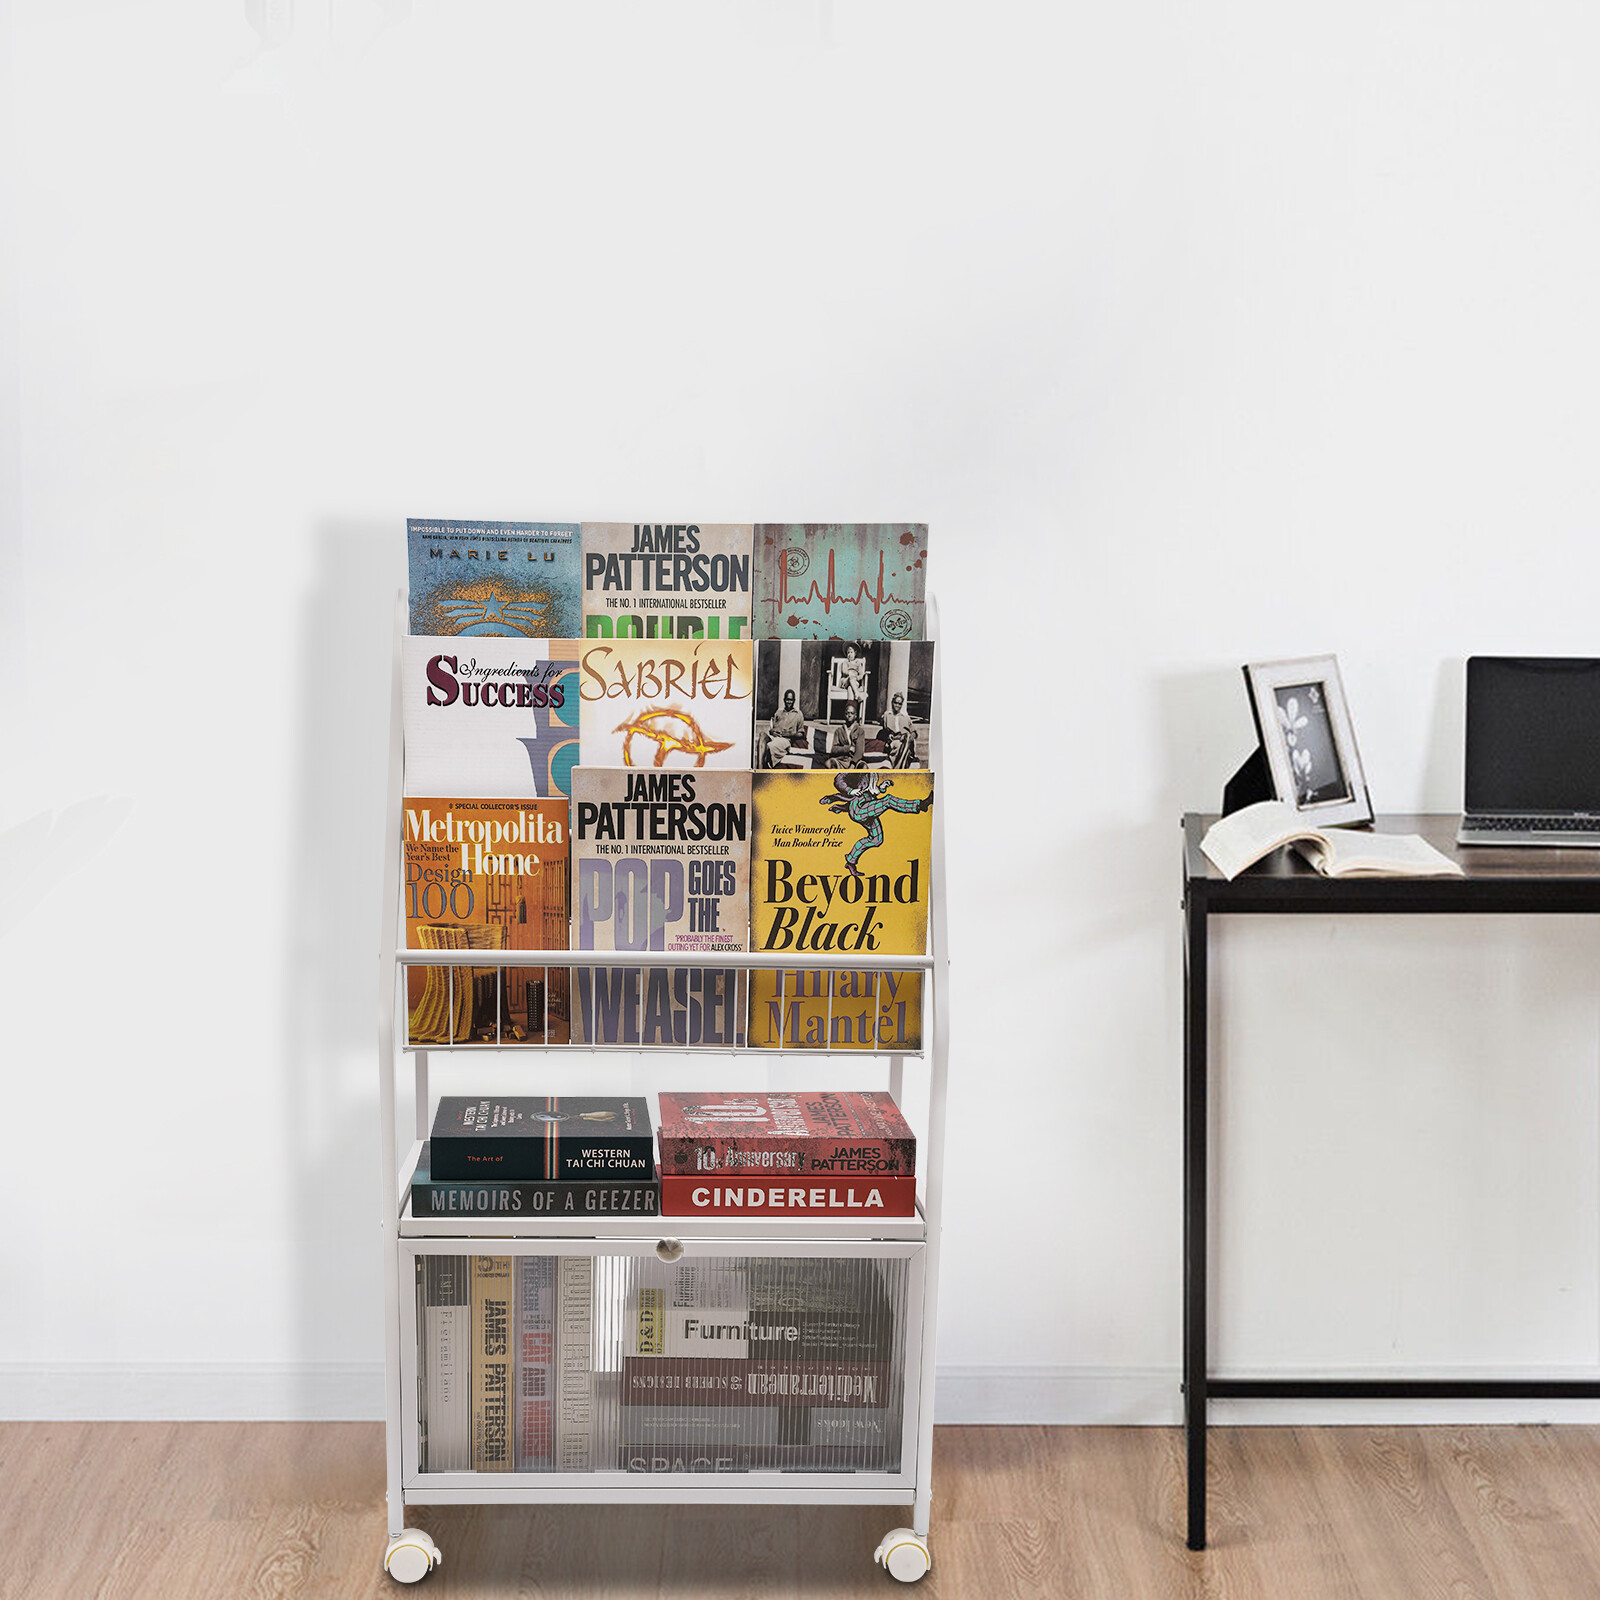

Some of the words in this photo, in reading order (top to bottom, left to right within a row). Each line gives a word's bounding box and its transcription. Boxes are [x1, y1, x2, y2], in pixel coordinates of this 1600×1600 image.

[447, 526, 454, 534] TO
[486, 528, 500, 536] AND
[516, 529, 540, 537] HARDER
[631, 525, 700, 553] JAMES
[430, 548, 508, 561] MARIE
[527, 551, 554, 561] LU
[586, 553, 749, 592] PATTERSON
[606, 597, 618, 608] THE
[619, 598, 631, 608] NO.
[633, 598, 637, 608] 1
[638, 598, 688, 609] INTERNATIONAL
[689, 598, 726, 609] BESTSELLER
[426, 655, 565, 708] SUCCESS
[460, 658, 539, 682] Ingredients
[541, 662, 562, 683] for
[624, 774, 696, 802] JAMES
[480, 803, 519, 811] COLLECTOR'S
[404, 809, 564, 853] Metropolita
[578, 802, 747, 841] PATTERSON
[771, 824, 793, 834] Twice
[795, 824, 824, 834] Winner
[823, 824, 835, 837] of
[833, 824, 846, 834] the
[405, 843, 419, 852] We
[420, 843, 444, 853] Name
[445, 844, 459, 853] the
[596, 844, 610, 855] THE
[611, 844, 623, 855] NO.
[625, 845, 629, 854] 1
[630, 844, 685, 855] INTERNATIONAL
[687, 845, 729, 856] BESTSELLER
[772, 838, 791, 848] Man
[792, 838, 821, 848] Booker
[821, 838, 843, 848] Prize
[406, 852, 430, 861] Year's
[432, 853, 450, 861] Best
[460, 843, 540, 877] Home
[406, 862, 473, 887] Design
[688, 860, 736, 896] GOES
[406, 882, 474, 919] 100
[763, 858, 920, 918] Beyond
[579, 858, 684, 951] POP
[688, 898, 720, 933] THE
[704, 935, 715, 943] THE
[715, 935, 733, 943] FINEST
[760, 905, 883, 951] Black
[667, 943, 689, 951] OUTING
[689, 943, 699, 951] YET
[700, 943, 711, 951] FOR
[711, 943, 724, 951] ALEX
[763, 1001, 909, 1044] Mantel
[805, 1101, 831, 1126] JAMES
[566, 1159, 583, 1168] TAI
[586, 1159, 605, 1168] CHI
[607, 1159, 646, 1168] CHUAN
[581, 1149, 631, 1158] WESTERN
[725, 1146, 805, 1171] Anniversary
[811, 1159, 899, 1172] PATTERSON
[830, 1147, 881, 1159] JAMES
[431, 1189, 522, 1211] MEMOIRS
[532, 1190, 555, 1211] OF
[564, 1191, 574, 1210] A
[585, 1189, 655, 1211] GEEZER
[691, 1187, 884, 1208] CINDERELLA
[484, 1298, 508, 1356] JAMES
[684, 1319, 798, 1341] Furniture
[523, 1332, 551, 1364] CAT
[523, 1367, 545, 1397] AND
[632, 1375, 680, 1389] DESIGNS
[747, 1373, 878, 1403] Mediterranean
[484, 1363, 508, 1462] PATTERSON
[523, 1400, 551, 1459] MOUSE
